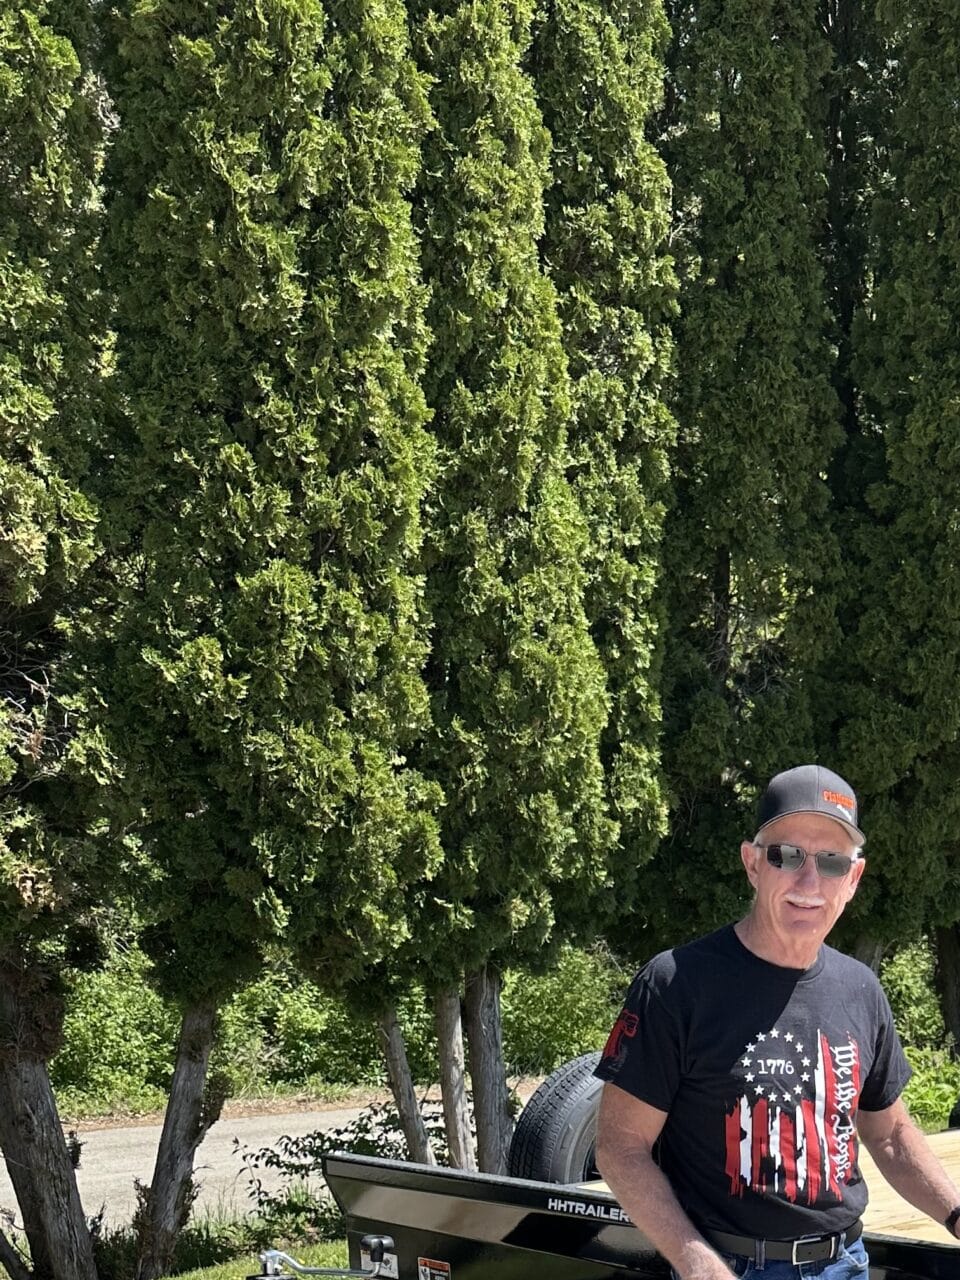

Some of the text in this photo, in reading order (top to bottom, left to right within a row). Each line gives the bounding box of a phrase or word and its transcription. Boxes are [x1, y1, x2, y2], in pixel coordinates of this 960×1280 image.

[757, 1058, 795, 1075] 1776
[829, 1040, 858, 1184] We the People
[547, 1197, 632, 1223] HHTRAILER
